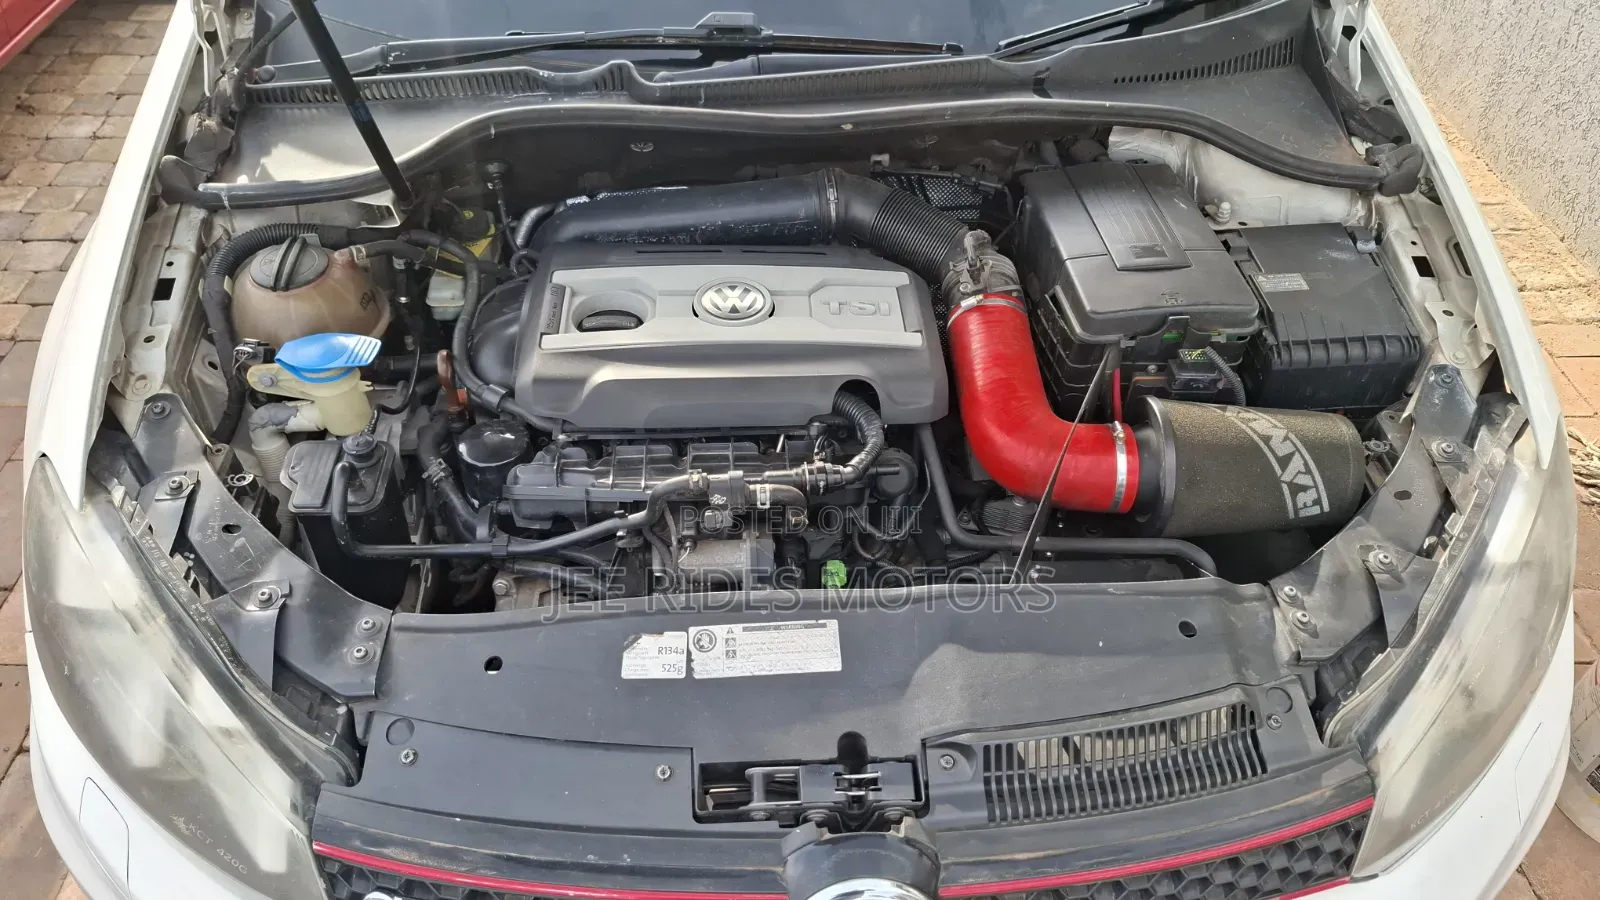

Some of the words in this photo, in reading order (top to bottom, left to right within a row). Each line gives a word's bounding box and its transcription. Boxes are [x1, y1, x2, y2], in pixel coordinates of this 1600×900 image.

[820, 300, 891, 317] TSI
[657, 646, 685, 656] R134a
[661, 663, 684, 676] 525g
[216, 848, 249, 876] 420G
